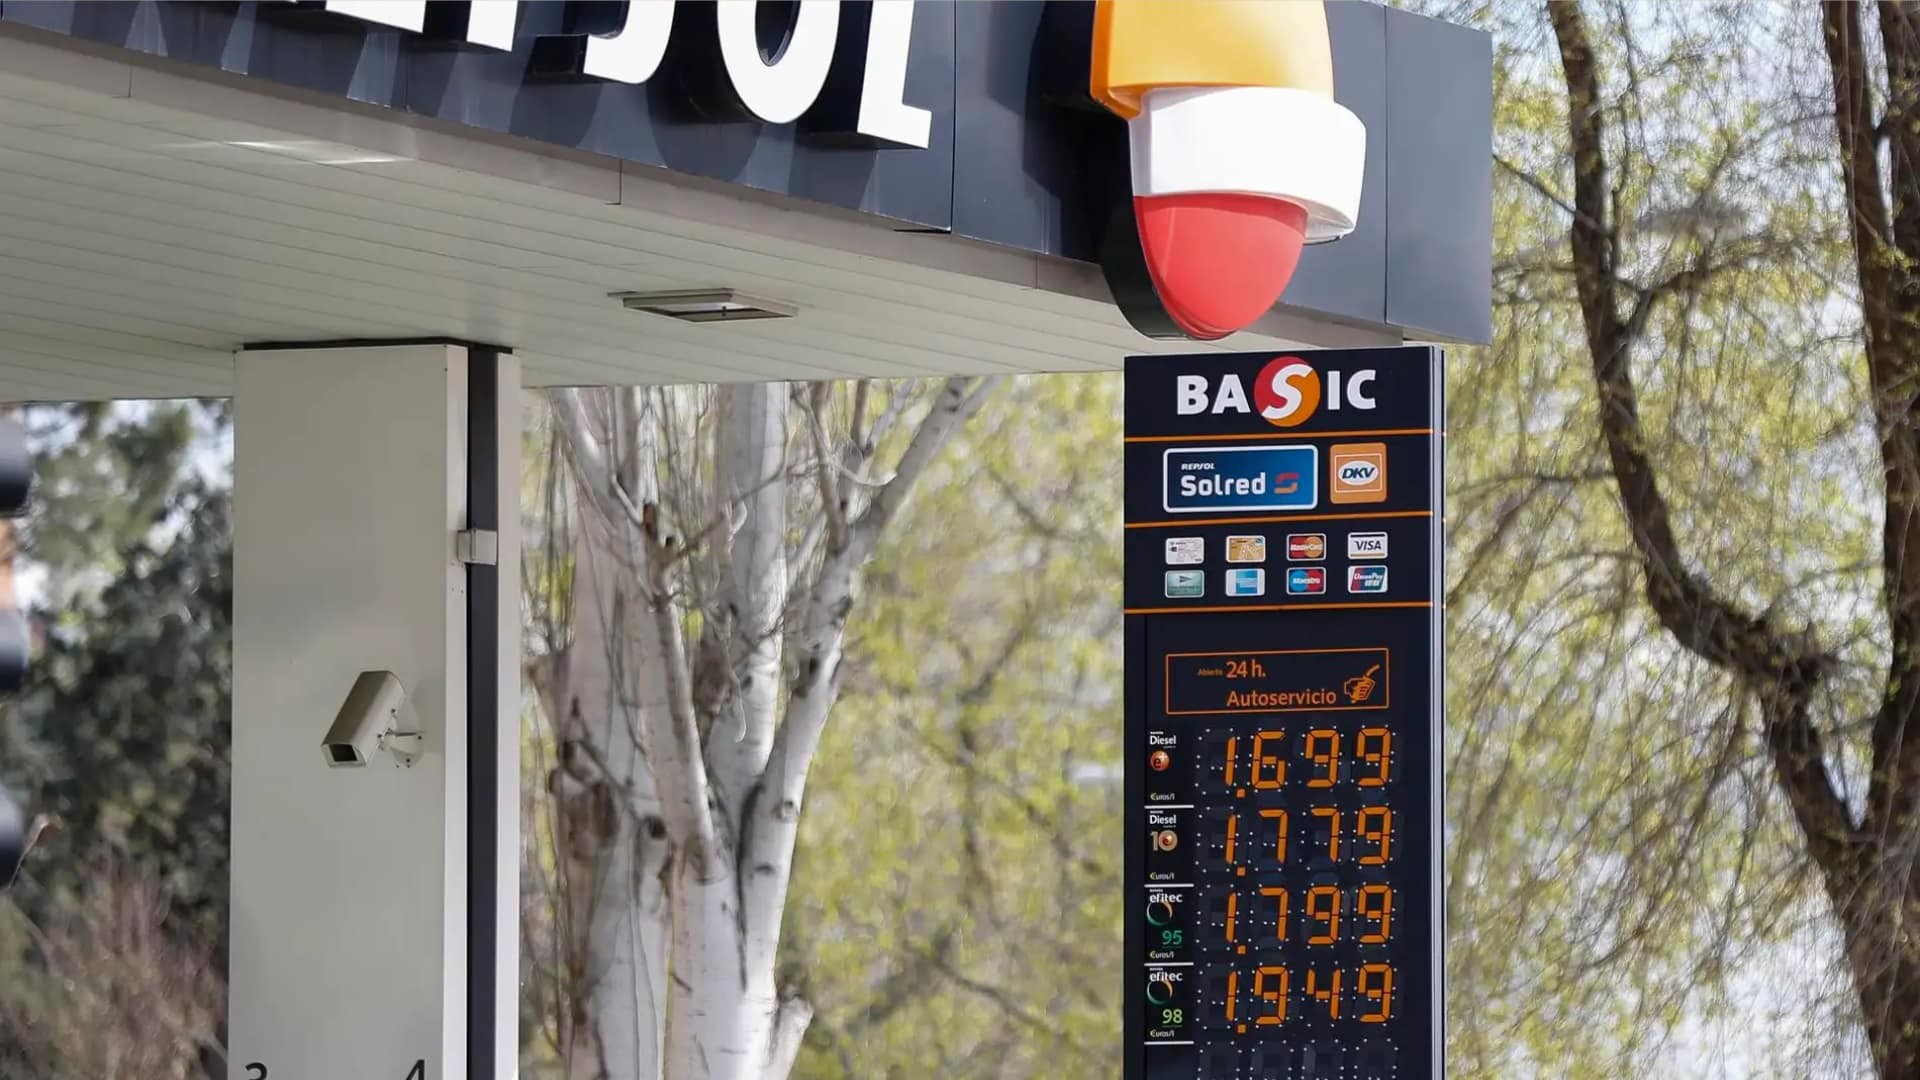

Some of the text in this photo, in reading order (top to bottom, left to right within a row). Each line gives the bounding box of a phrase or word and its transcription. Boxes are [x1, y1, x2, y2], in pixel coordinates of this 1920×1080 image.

[1176, 363, 1377, 420] BASIC
[1341, 467, 1376, 480] DKV
[1180, 472, 1266, 497] Solred
[1355, 540, 1382, 551] VISA
[1226, 660, 1248, 678] 24
[1251, 659, 1267, 678] h.
[1226, 688, 1337, 707] Autoservicio
[1149, 735, 1177, 745] Diesel
[1224, 728, 1392, 798] 1.699
[1149, 814, 1177, 825] Diesel
[1224, 806, 1392, 876] 1.779
[1149, 893, 1183, 903] efitec
[1224, 884, 1392, 954] 1.799
[1162, 930, 1183, 945] 95
[1149, 971, 1183, 982] efitec
[1225, 963, 1393, 1034] 1.949
[1162, 1008, 1183, 1024] 98
